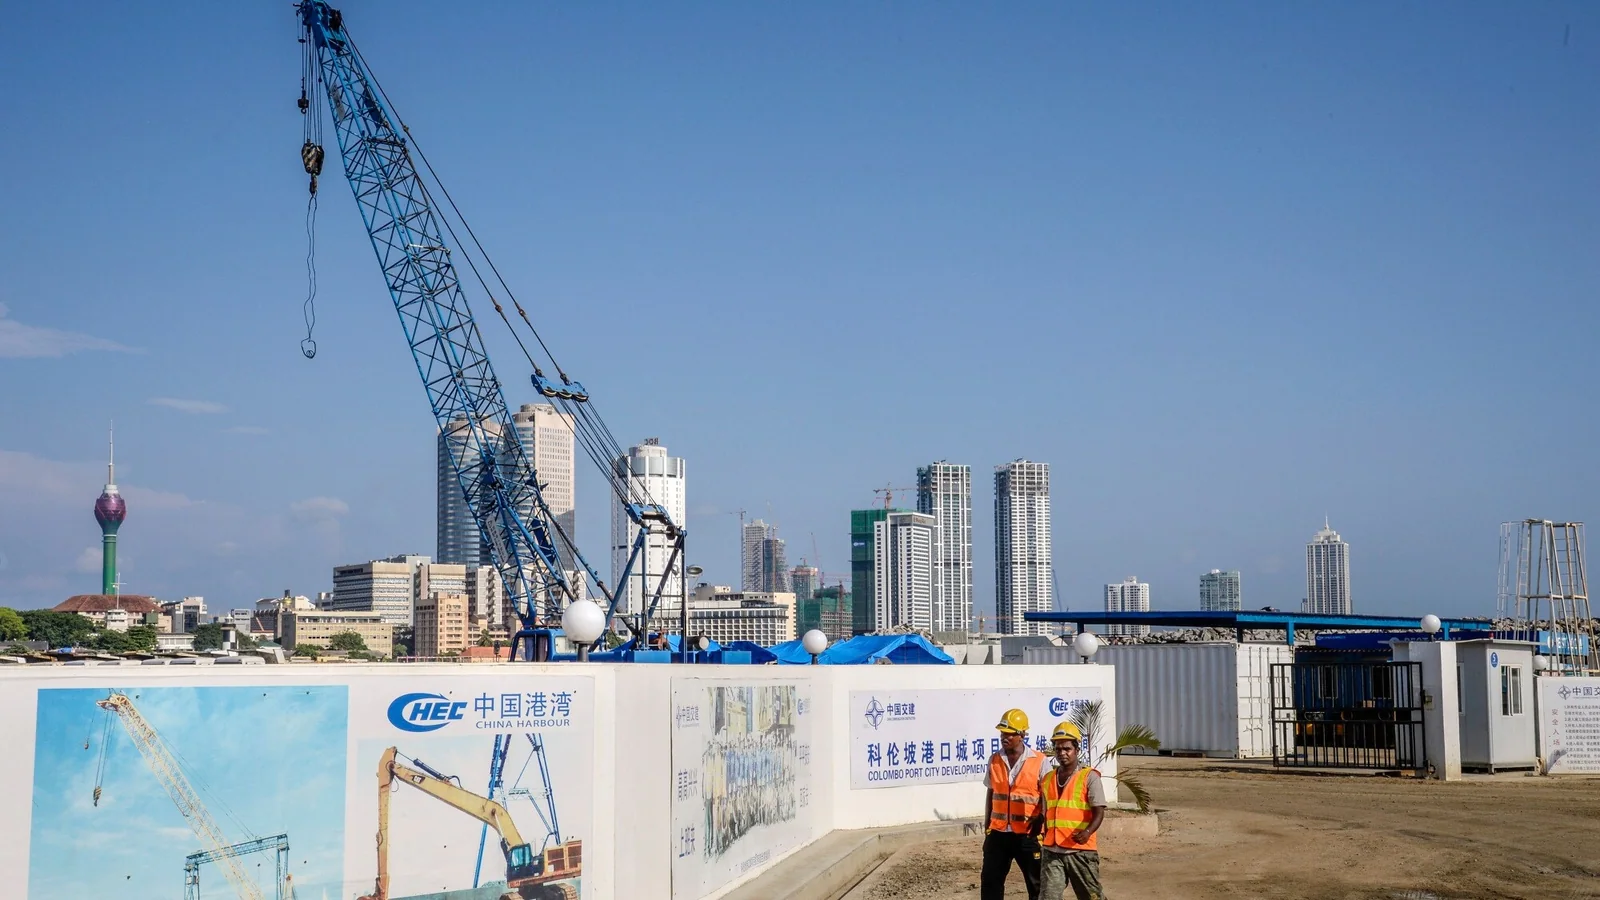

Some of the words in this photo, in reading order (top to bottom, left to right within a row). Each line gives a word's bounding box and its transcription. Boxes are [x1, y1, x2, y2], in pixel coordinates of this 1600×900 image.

[387, 692, 468, 733] CHEC
[474, 691, 572, 719] 中国港湾
[887, 703, 915, 716] 中国交建
[1049, 697, 1069, 717] CHEC
[476, 720, 513, 729] CHINA
[517, 718, 570, 728] HARBOUR
[868, 769, 904, 781] COLOMBO
[905, 767, 922, 778] PORT
[925, 765, 940, 777] CITY
